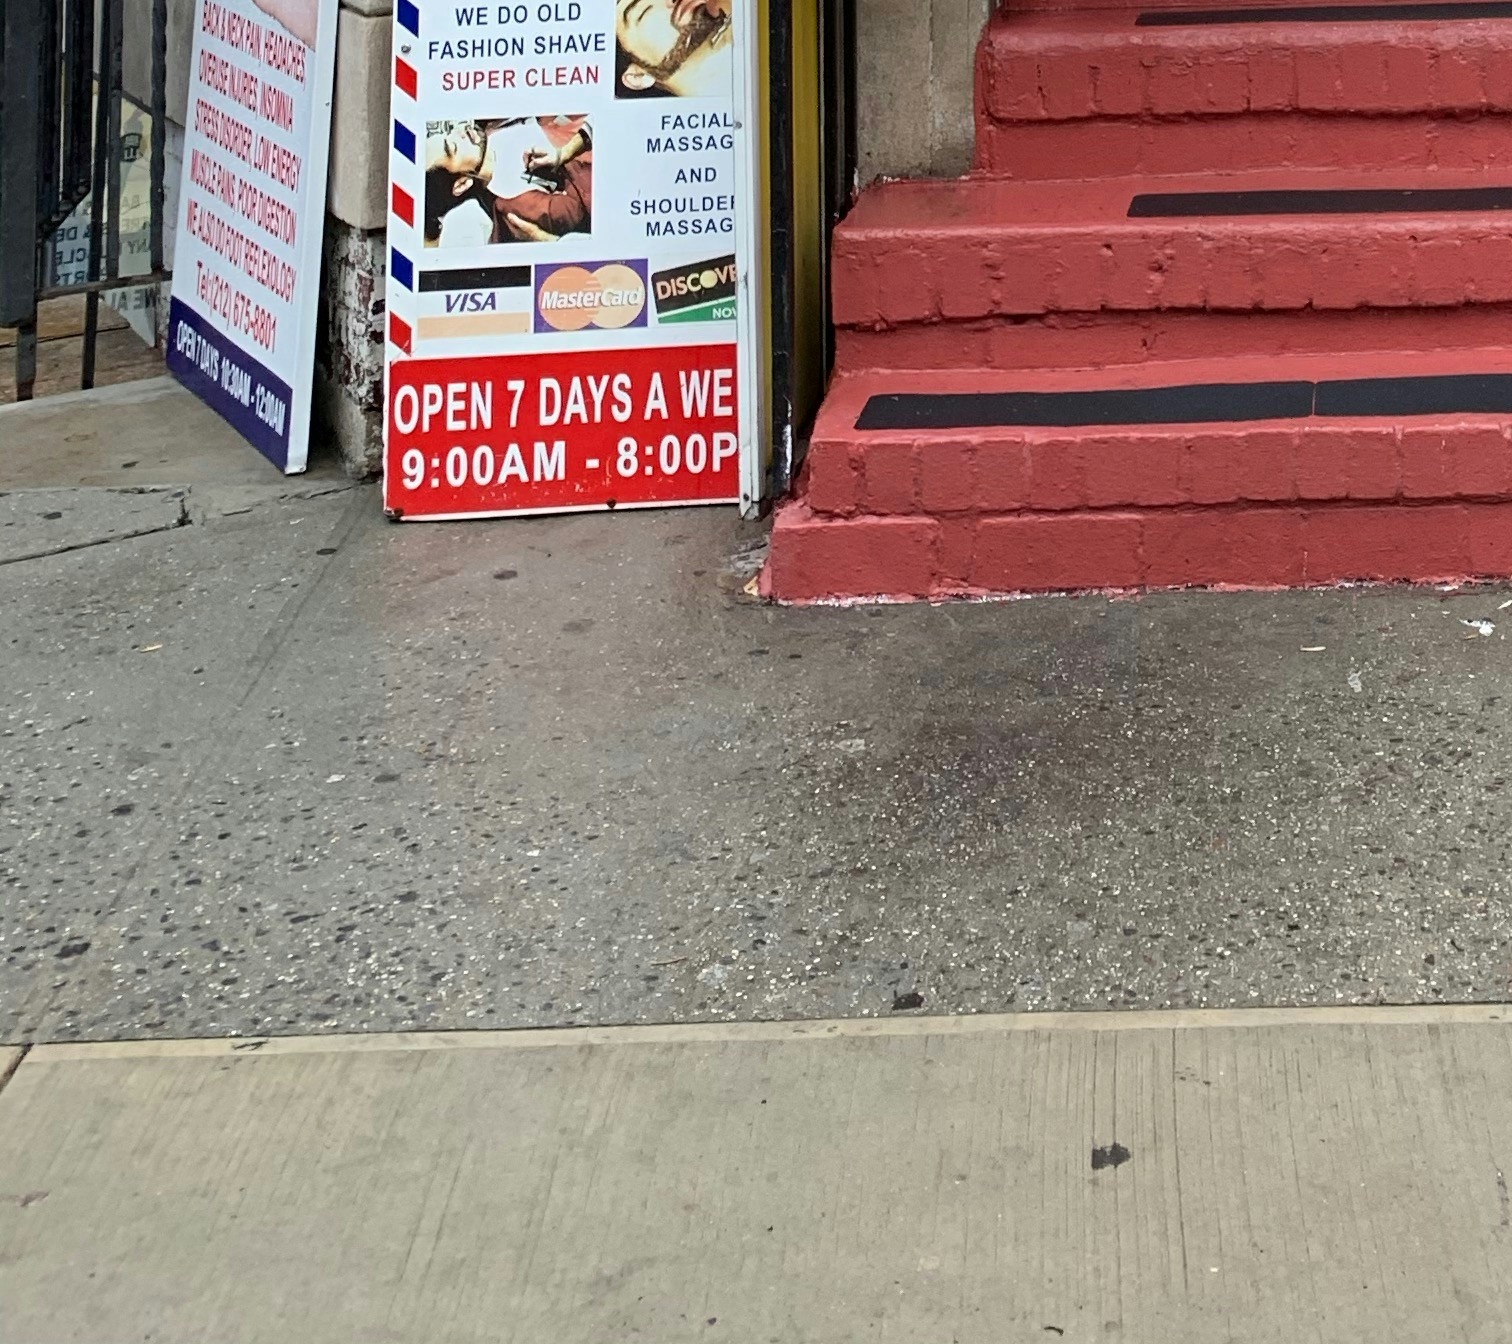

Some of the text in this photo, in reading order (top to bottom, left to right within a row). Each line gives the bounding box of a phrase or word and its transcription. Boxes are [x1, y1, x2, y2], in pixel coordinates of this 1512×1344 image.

[203, 0, 220, 39] BACK
[455, 2, 581, 26] WE DO OLD
[428, 33, 606, 60] FASHION SHAVE
[442, 65, 600, 91] SUPER CLEAN
[661, 112, 734, 131] FACIAL
[646, 134, 734, 154] MASSAG
[674, 167, 717, 184] AND
[646, 217, 734, 237] MASSAG
[656, 263, 736, 300] DISCOVE
[445, 292, 498, 313] VISA
[540, 287, 644, 311] MasterCard
[393, 368, 734, 435] OPEN 7 DAYS A WE
[401, 440, 567, 491] 9:00AM
[616, 431, 738, 479] 8:00P
